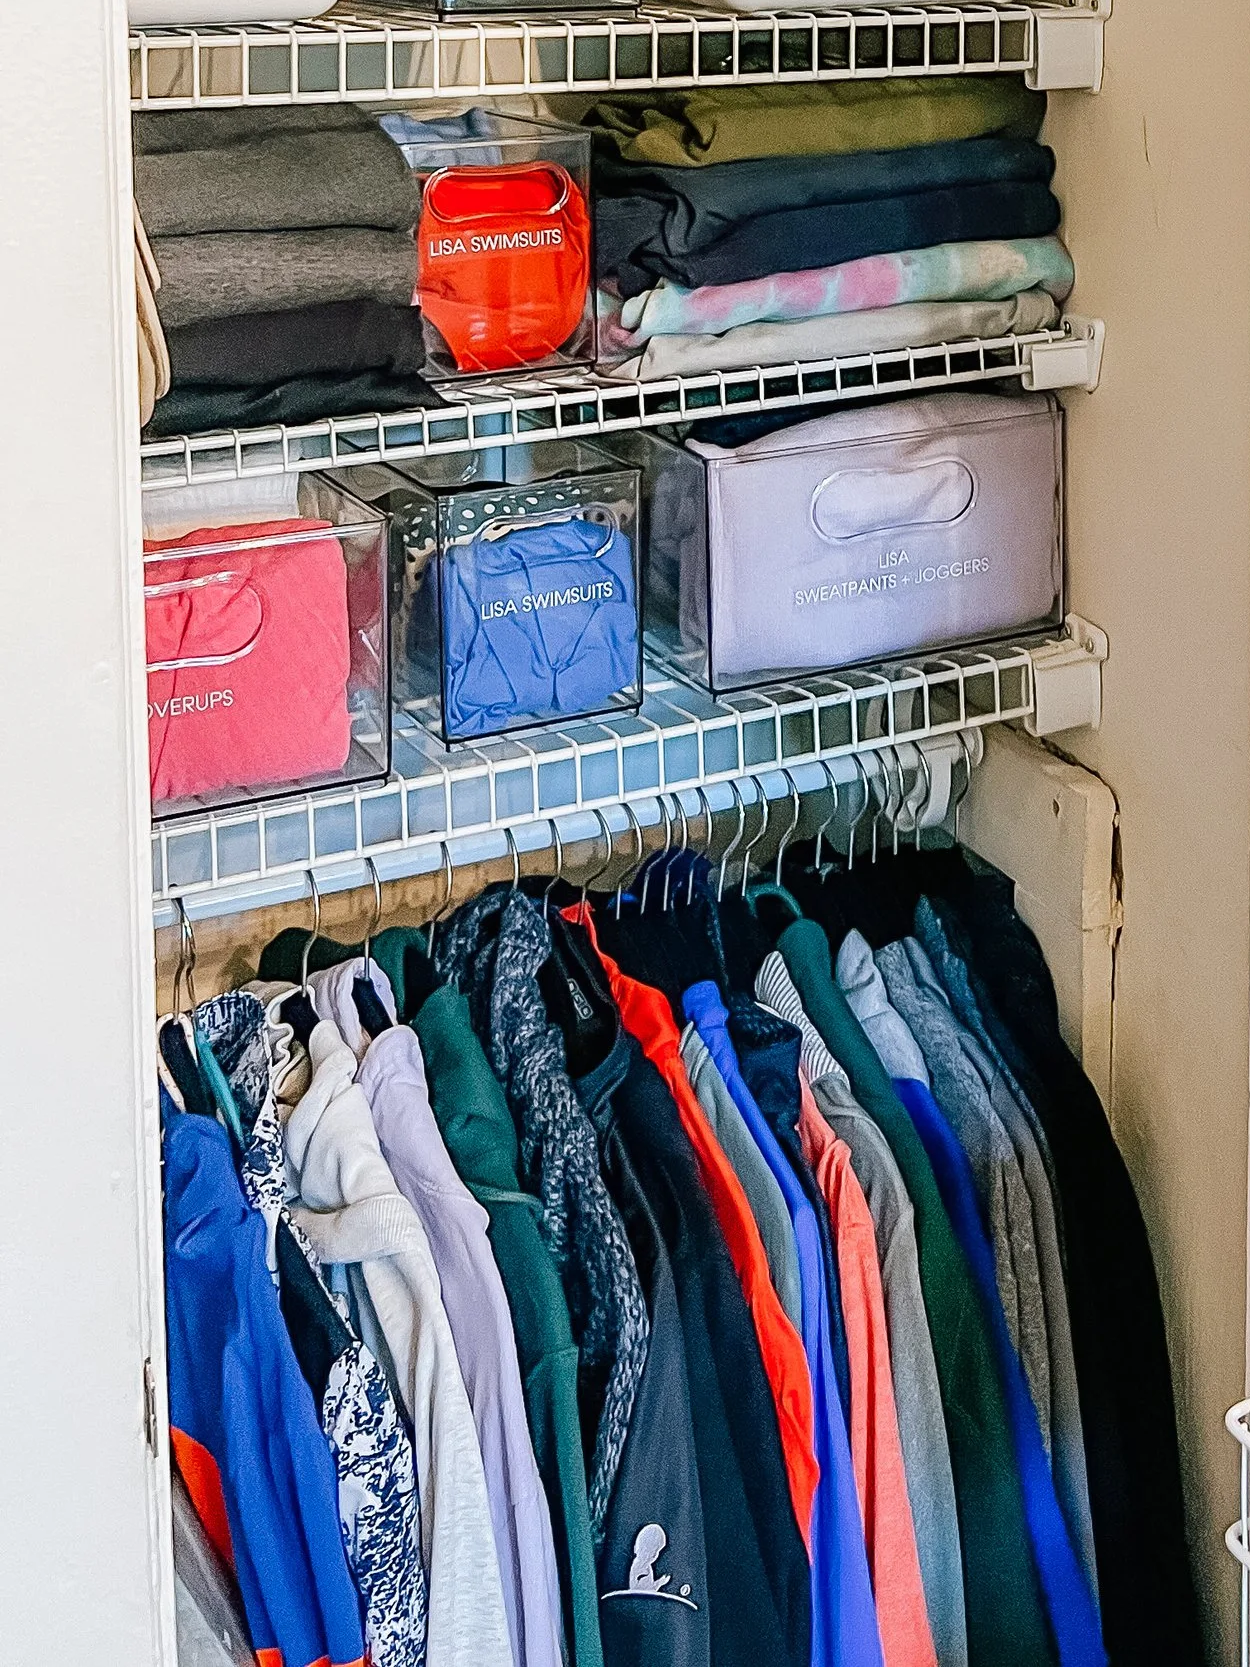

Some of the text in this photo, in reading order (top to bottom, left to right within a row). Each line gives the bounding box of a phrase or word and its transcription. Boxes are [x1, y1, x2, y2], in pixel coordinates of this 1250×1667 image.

[430, 229, 562, 257] LISA SWIMSUITS
[879, 550, 910, 568] LISA
[795, 557, 989, 605] SWEATPANTS + JOGGERS
[481, 582, 612, 620] LISA SWIMSUITS
